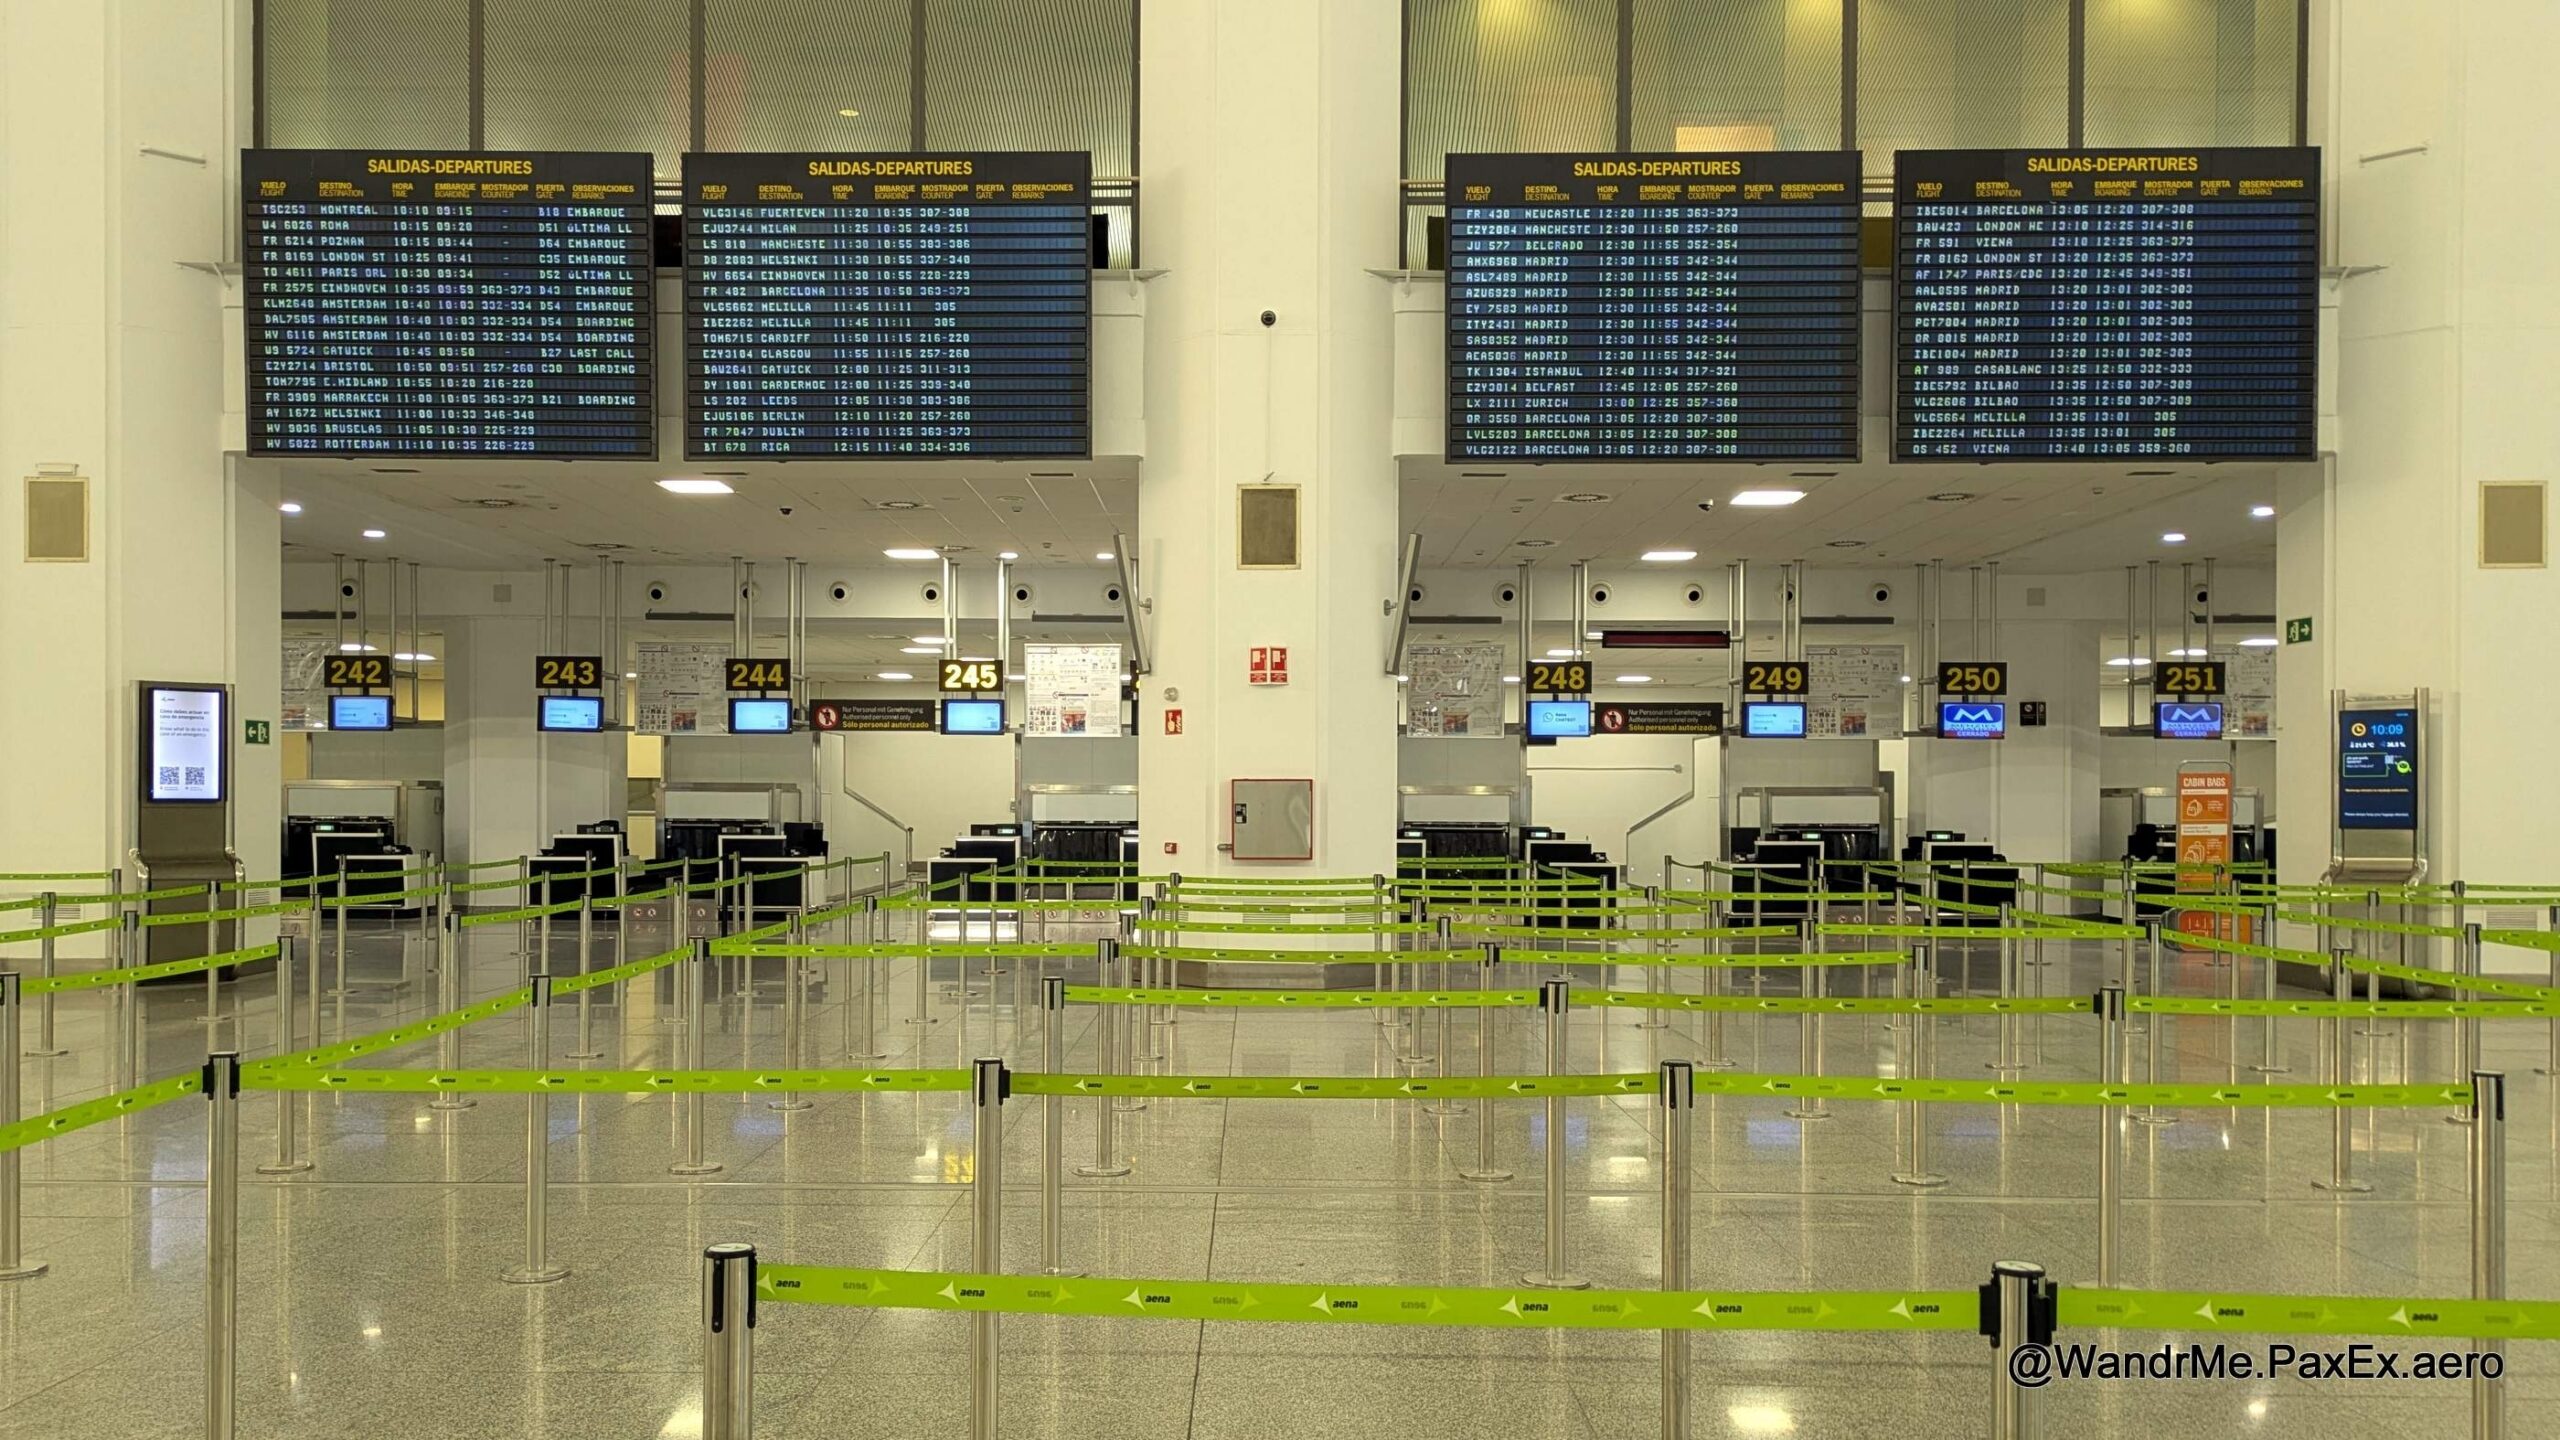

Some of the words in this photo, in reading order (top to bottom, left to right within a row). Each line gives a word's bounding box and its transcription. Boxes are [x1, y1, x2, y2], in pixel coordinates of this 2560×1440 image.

[369, 160, 532, 174] SALIDAS-DEPARTURES
[810, 162, 972, 175] SALIDAS-DEPARTURES
[1575, 162, 1740, 175] SALIDAS-DEPARTURES
[2028, 157, 2197, 171] SALIDAS-DEPARTURES
[320, 182, 352, 190] DESTINO
[435, 183, 476, 191] EMBARQUE
[536, 184, 565, 192] PUERTA
[703, 185, 727, 193] VUELO
[759, 185, 792, 193] DESTINO
[976, 184, 1004, 192] PUERTA
[1467, 186, 1491, 194] VUELO
[1640, 185, 1682, 193] EMBARQUE
[1917, 183, 1942, 191] VUELO
[2051, 182, 2073, 190] HORA
[2145, 181, 2193, 189] MOSTRADOR
[2240, 180, 2303, 188] OBSERVACIONES
[321, 205, 377, 214] MONTREAL
[567, 208, 624, 217] EMBARQUE
[761, 209, 825, 217] FUERTEVEN
[1643, 209, 1678, 218] 11:35
[1687, 208, 1737, 217] 363-373
[1977, 206, 2043, 215] BARCELONA
[321, 221, 349, 230] ROMA
[761, 224, 796, 233] MILAN
[834, 224, 868, 233] 11:25
[263, 236, 277, 245] FR
[285, 236, 313, 245] 6214
[321, 237, 364, 245] POZNAN
[1977, 238, 2012, 247] VIENA
[2097, 237, 2133, 246] 12:25
[1467, 241, 1480, 250] JU
[1489, 241, 1509, 250] 577
[1526, 241, 1583, 250] BELGRADO
[762, 256, 817, 264] HELSINKI
[1976, 269, 2042, 278] PARIS/CDG
[322, 284, 386, 293] EINDHOVEN
[762, 287, 825, 295] BARCELONA
[834, 287, 869, 295] 11:35
[1525, 304, 1567, 313] MADRID
[1687, 303, 1736, 312] 342-344
[1975, 317, 2019, 326] MADRID
[761, 334, 810, 342] CARDIFF
[877, 334, 911, 342] 11:15
[570, 349, 597, 357] LAST
[606, 349, 634, 358] CALL
[324, 362, 373, 371] BRISTOL
[1975, 365, 2041, 374] CASABLANC
[1526, 367, 1582, 376] ISTANBUL
[1687, 367, 1736, 375] 317-321
[1975, 381, 2018, 390] BILBAO
[324, 393, 388, 402] MARRAKECH
[1525, 399, 1568, 407] ZURICH
[763, 412, 804, 420] BERLIN
[763, 427, 804, 436] DUBLIN
[325, 440, 389, 448] ROTTERDAM
[762, 443, 789, 451] RIGA
[331, 661, 381, 683] 242
[543, 662, 594, 684] 243
[733, 664, 784, 686] 244
[945, 664, 997, 688] 245
[1534, 666, 1585, 689] 248
[1750, 667, 1801, 690] 249
[1947, 668, 2000, 691] 250
[2167, 667, 2216, 690] 251
[887, 707, 924, 715] Genehmigung
[859, 722, 889, 730] personal
[2371, 725, 2403, 735] 10:09
[2183, 778, 2205, 787] CABIN
[2207, 777, 2225, 786] BAGS
[776, 1280, 800, 1289] aena
[1146, 1296, 1170, 1304] aena
[1333, 1301, 1357, 1309] aena
[1523, 1304, 1548, 1312] aena
[2218, 1309, 2244, 1317] aena
[2413, 1314, 2438, 1322] aena
